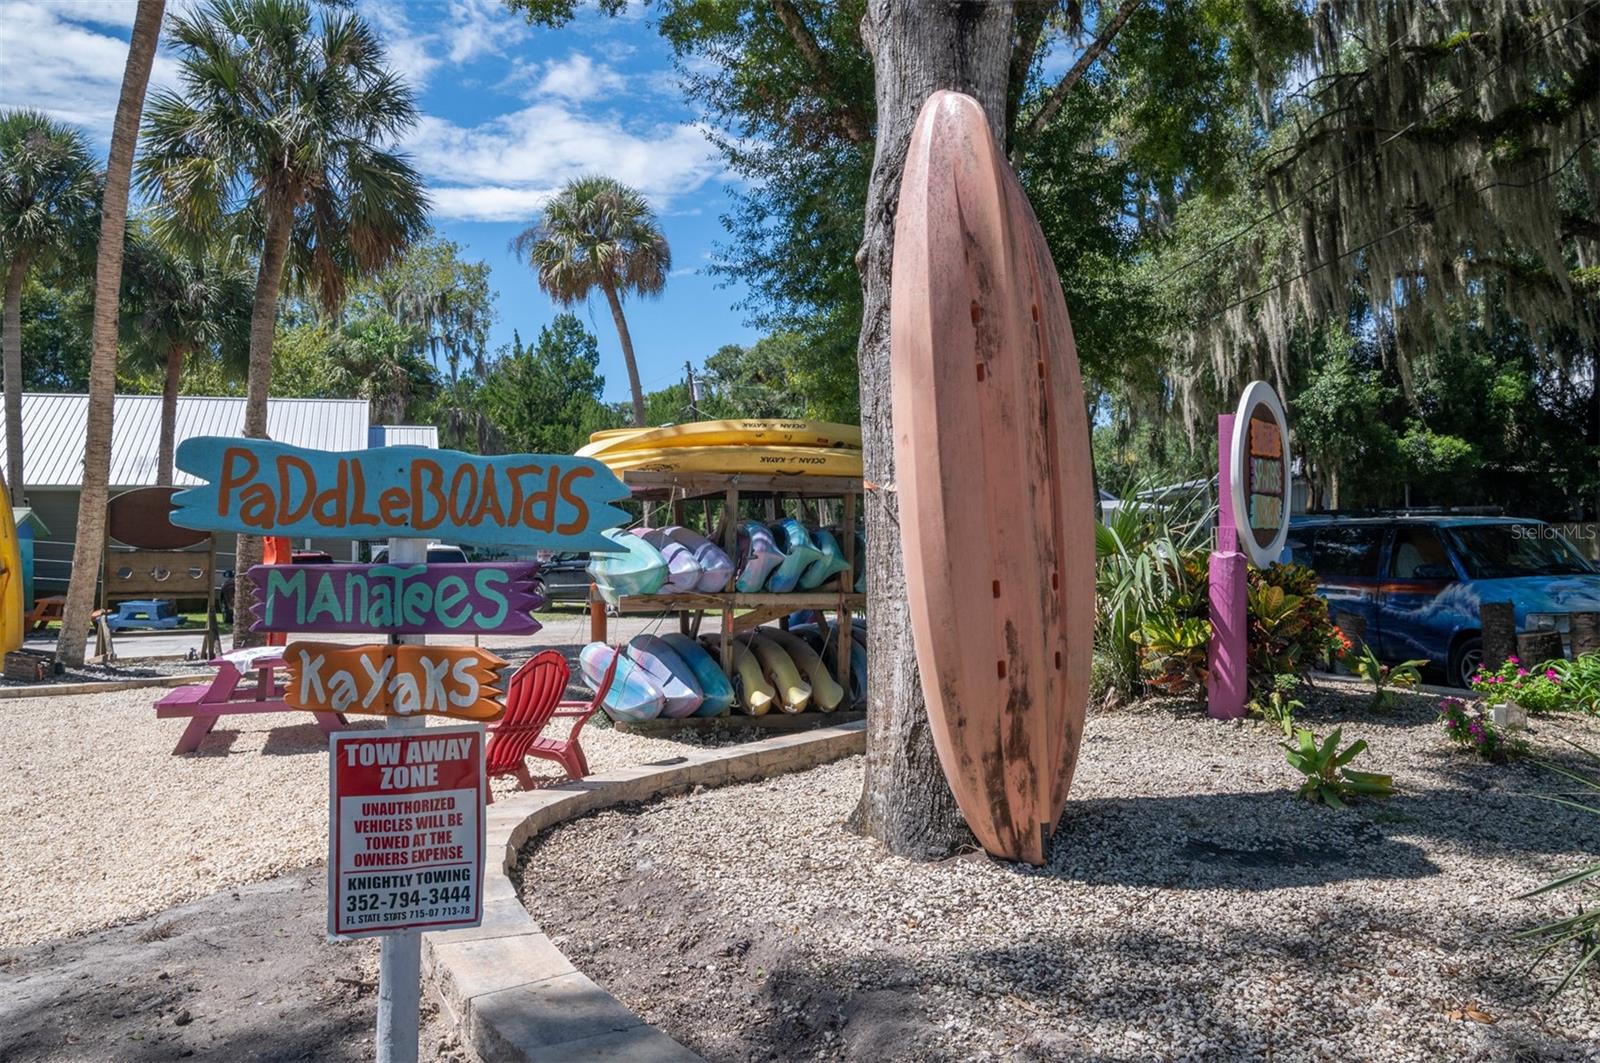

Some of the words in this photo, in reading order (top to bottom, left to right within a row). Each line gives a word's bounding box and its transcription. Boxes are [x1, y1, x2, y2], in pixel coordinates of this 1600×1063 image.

[344, 743, 402, 767] TOW
[406, 738, 473, 763] AWAY
[380, 766, 439, 790] ZONE
[362, 797, 456, 816] UNAUTHORIZED
[354, 818, 413, 834] VEHICLES
[416, 815, 445, 830] WILL
[448, 813, 463, 827] BE
[365, 835, 410, 850] TOWED
[412, 833, 426, 847] AT
[430, 830, 453, 845] THE
[354, 851, 408, 867] OWNERS
[412, 846, 463, 863] EXPENSE
[347, 874, 413, 891] KNIGHTLY
[416, 868, 471, 885] TOWING
[346, 886, 471, 912] 352-794-3444
[346, 915, 356, 925] FL
[358, 913, 381, 923] STATE
[409, 908, 439, 919] 715-07
[442, 906, 470, 916] 713-78
